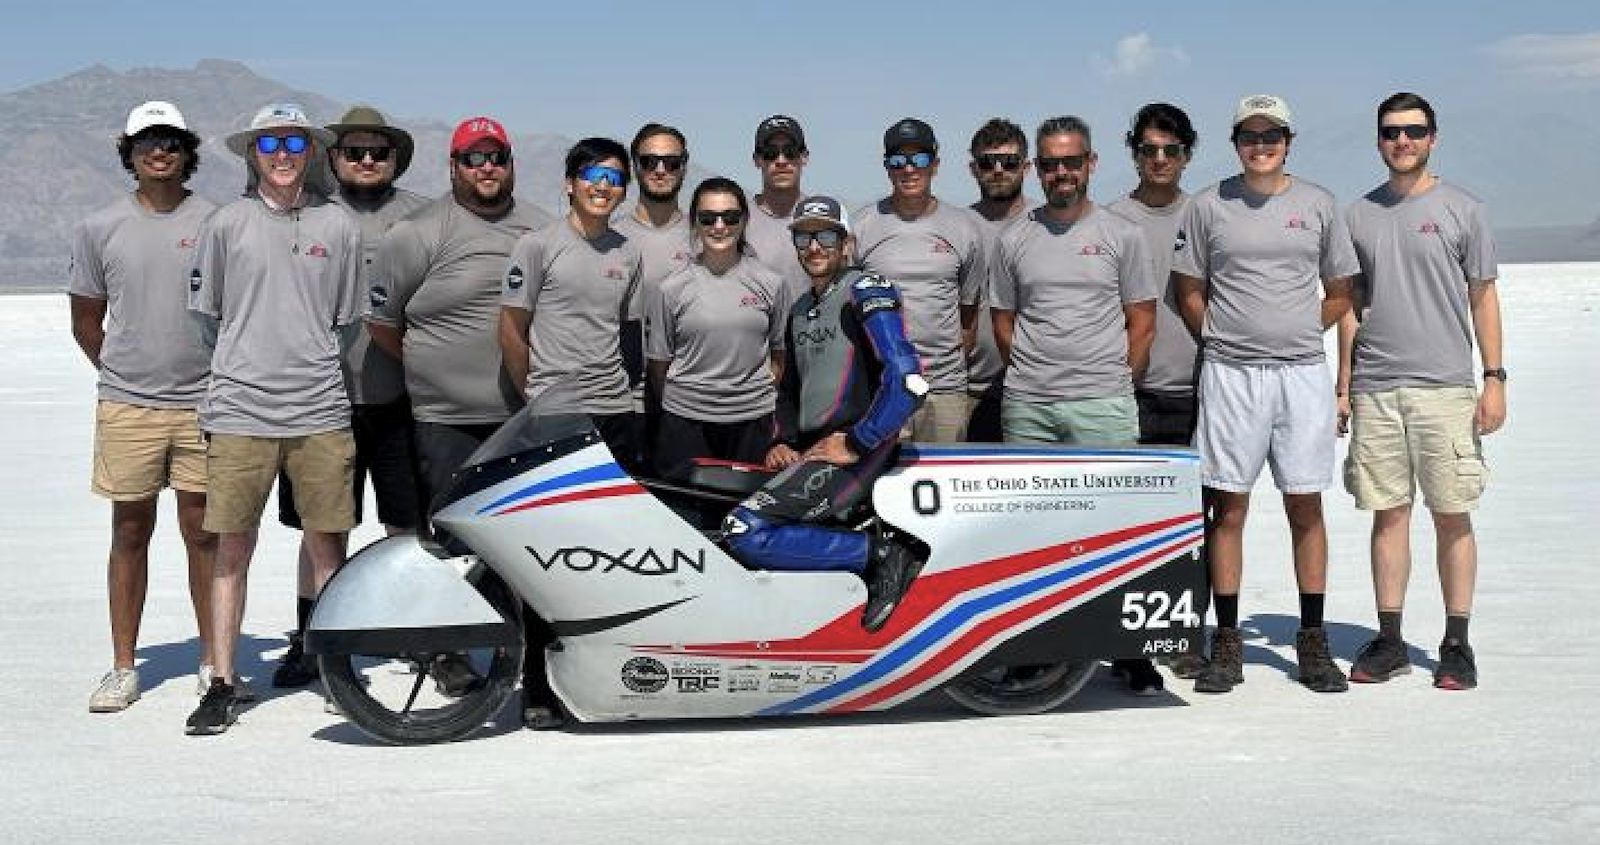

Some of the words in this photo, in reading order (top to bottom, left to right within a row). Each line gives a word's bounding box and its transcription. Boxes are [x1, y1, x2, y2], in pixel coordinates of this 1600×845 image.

[949, 477, 983, 493] THE
[987, 476, 1028, 491] OHIO
[1031, 475, 1081, 490] STATE
[1083, 473, 1178, 489] UNIVERSITY
[954, 501, 1004, 513] COLLEGE
[1007, 501, 1023, 513] OF
[1024, 499, 1097, 512] ENGINEERING
[524, 545, 706, 576] VOXAN
[1120, 589, 1197, 631] 524
